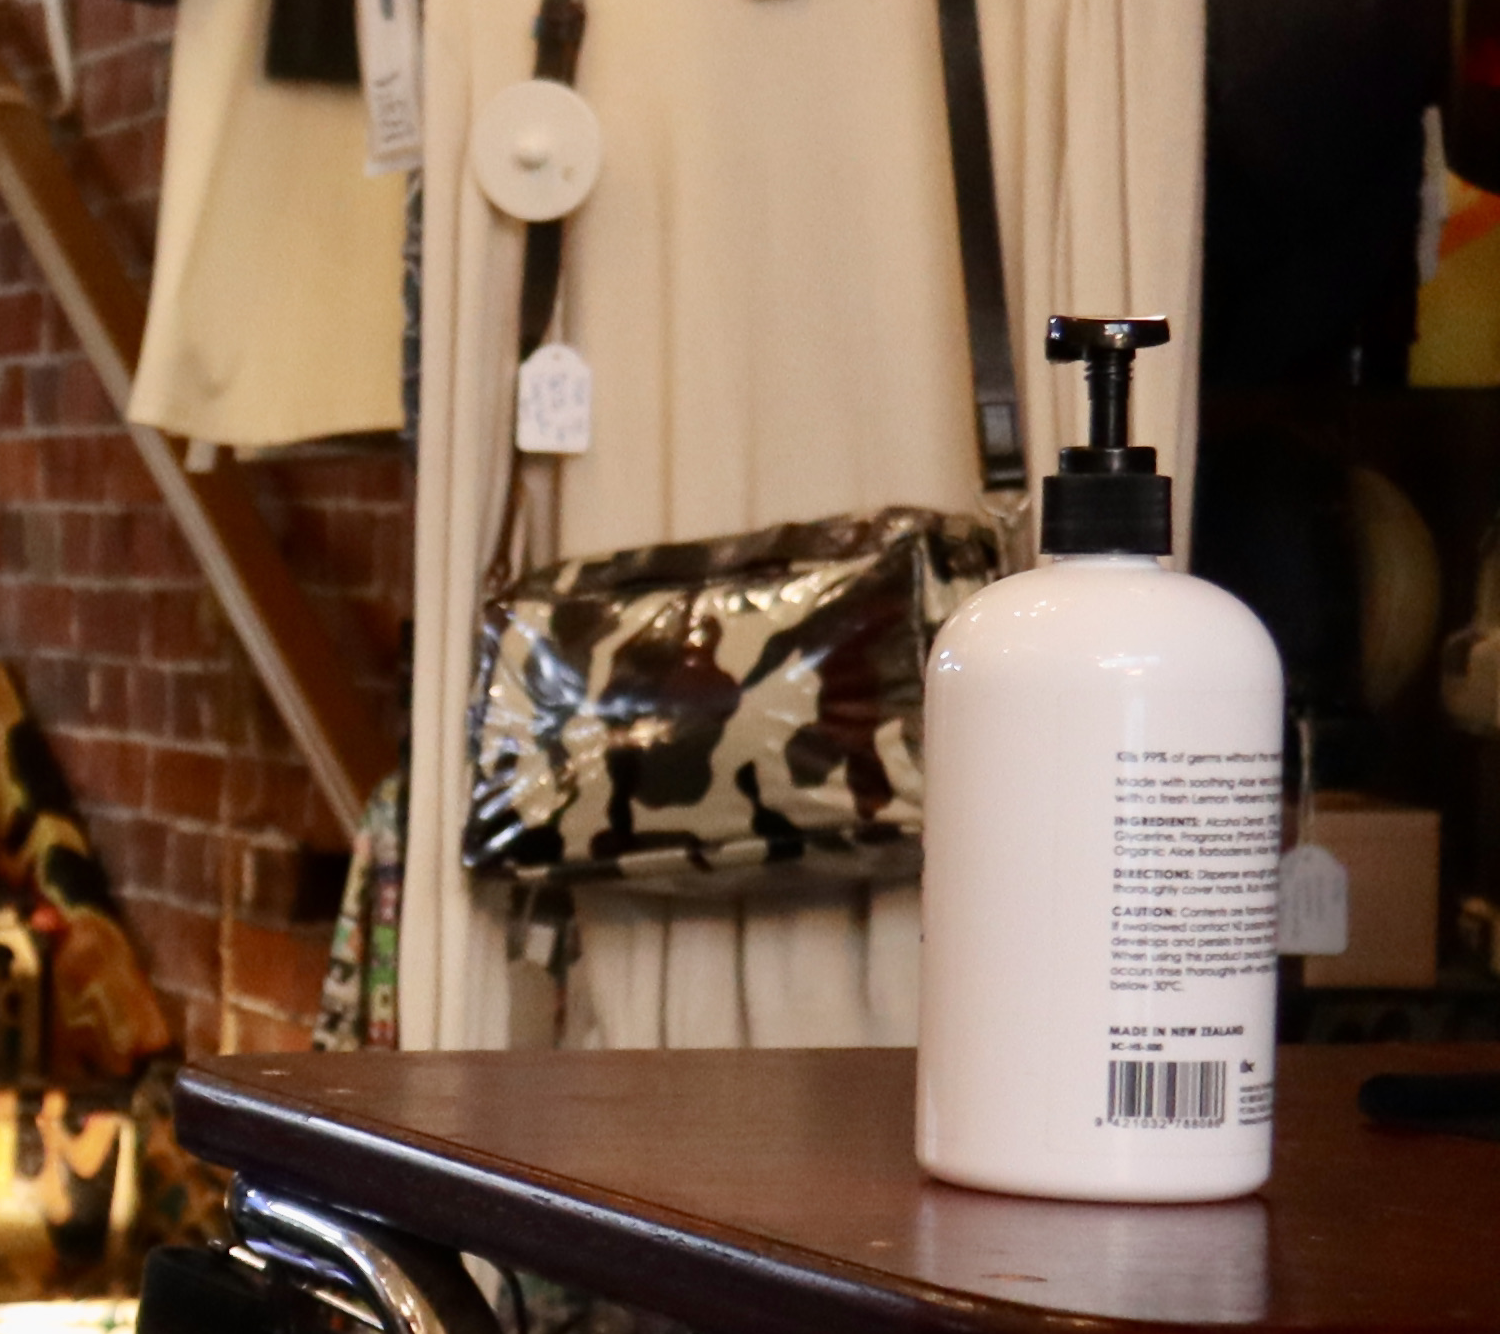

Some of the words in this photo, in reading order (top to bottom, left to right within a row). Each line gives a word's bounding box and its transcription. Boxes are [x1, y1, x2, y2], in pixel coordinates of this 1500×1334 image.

[1171, 752, 1185, 763] of
[1109, 1025, 1149, 1037] MADE
[1152, 1025, 1166, 1037] IN
[1170, 1025, 1197, 1037] NEW
[1200, 1024, 1244, 1037] ZEALAND
